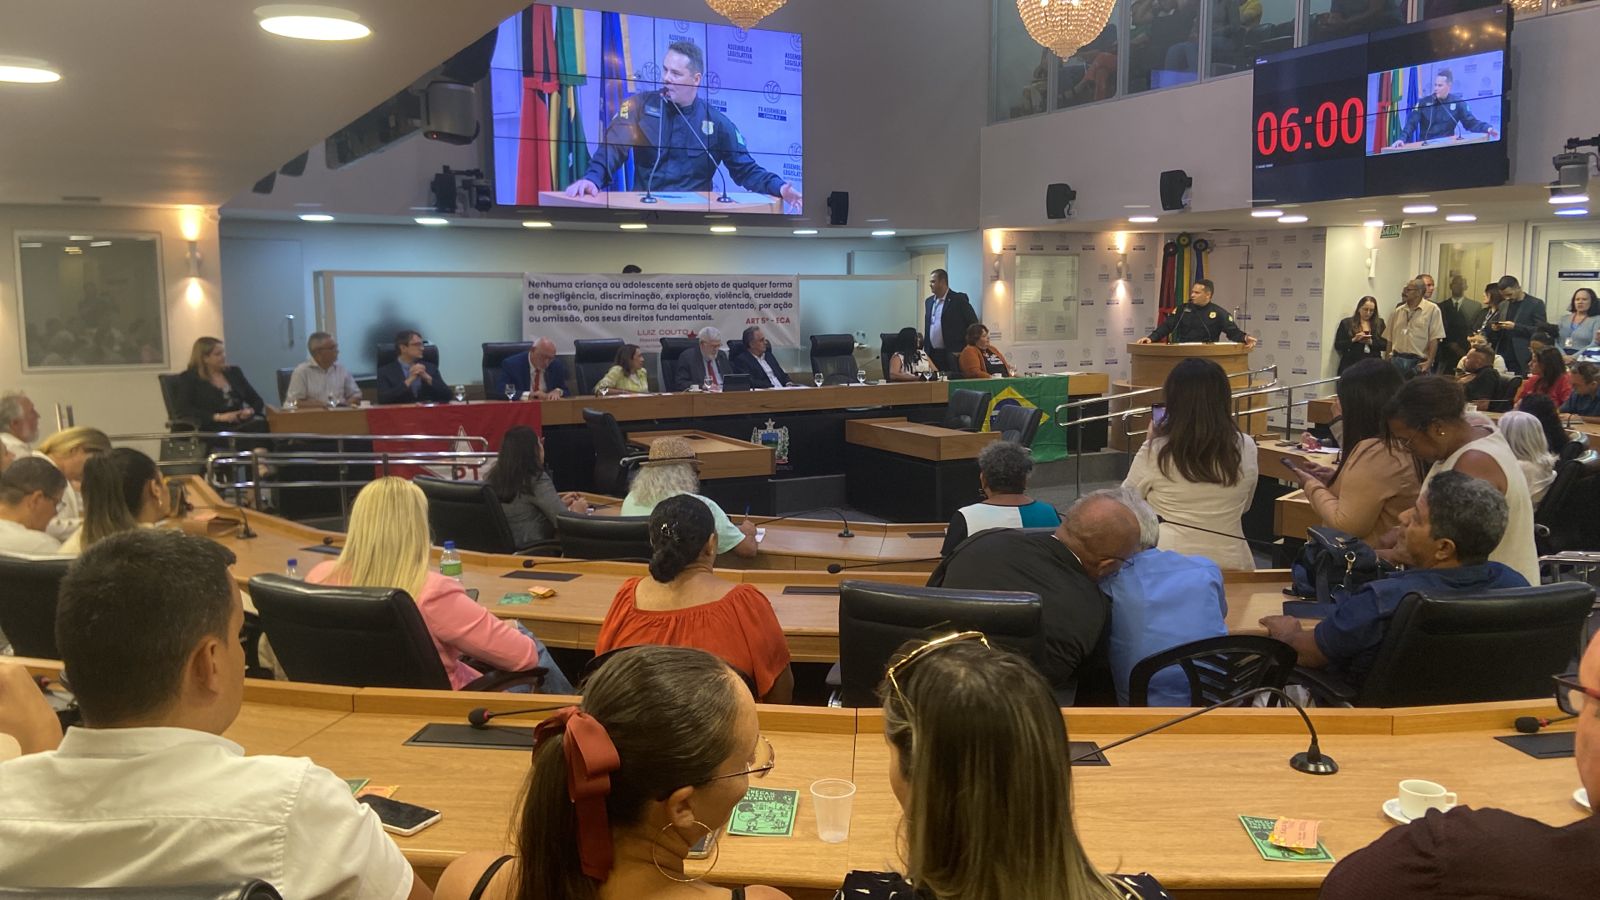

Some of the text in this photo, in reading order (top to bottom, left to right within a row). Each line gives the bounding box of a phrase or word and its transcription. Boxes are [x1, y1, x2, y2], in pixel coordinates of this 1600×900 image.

[1257, 97, 1364, 155] 06:00
[528, 280, 572, 289] Nenhuma
[574, 281, 608, 290] criança
[622, 281, 673, 289] adolescente
[675, 281, 692, 289] será
[694, 281, 719, 290] objeto
[721, 281, 731, 289] de
[732, 281, 767, 290] qualquer
[769, 280, 792, 288] forma
[528, 291, 792, 302] de negligência, discriminação, exploração, violência, crueldade
[537, 303, 580, 313] opressão,
[582, 303, 613, 313] punido
[629, 303, 654, 311] forma
[656, 303, 667, 311] da
[669, 302, 679, 310] lei
[681, 302, 717, 312] qualquer
[719, 302, 757, 311] atentado,
[759, 302, 771, 311] por
[773, 301, 793, 311] ação
[529, 315, 541, 323] ou
[542, 314, 583, 324] omissão,
[623, 314, 654, 322] direitos
[655, 313, 714, 322] fundamentais.
